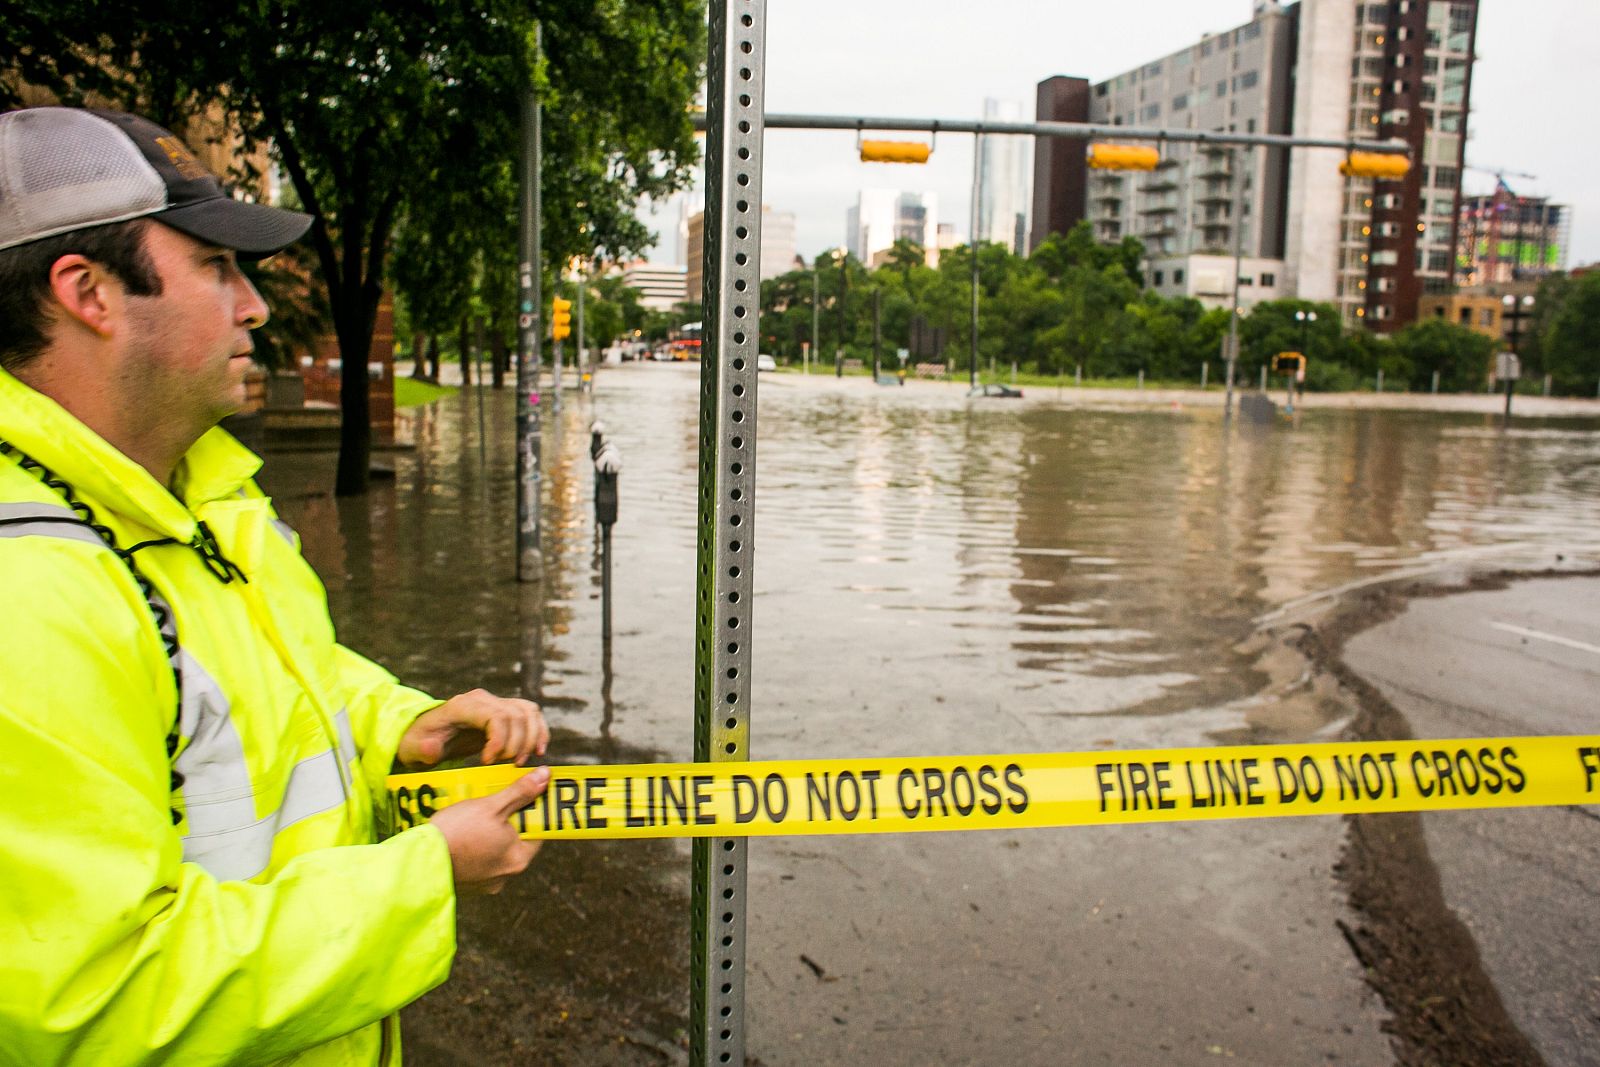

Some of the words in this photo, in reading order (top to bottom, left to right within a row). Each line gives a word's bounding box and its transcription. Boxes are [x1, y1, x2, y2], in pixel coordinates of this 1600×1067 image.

[624, 776, 717, 828] LINE
[732, 773, 789, 824] DO
[806, 770, 881, 822] NOT
[898, 764, 1029, 819] CROSS
[1096, 762, 1176, 812] FIRE
[1186, 759, 1265, 808] LINE
[1274, 756, 1324, 804] DO
[1334, 753, 1399, 801] NOT
[1411, 746, 1526, 798] CROSS
[1578, 747, 1600, 793] F
